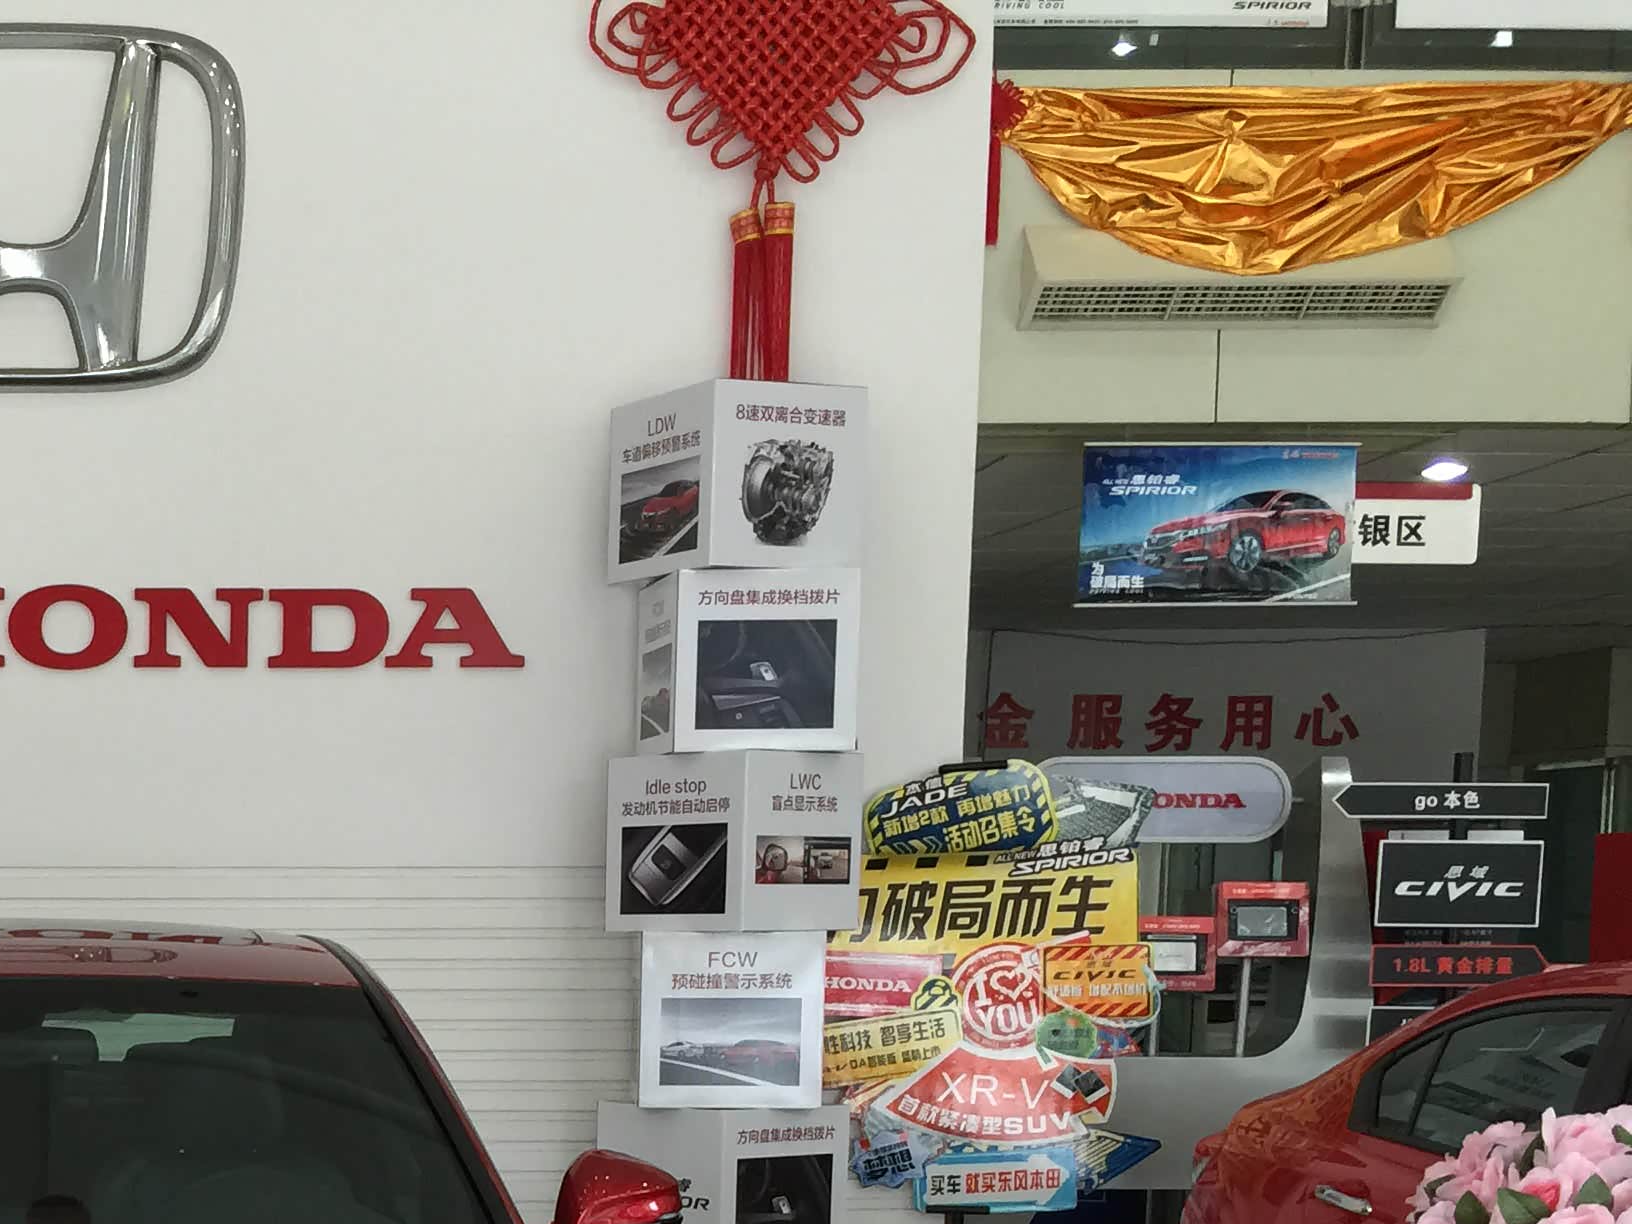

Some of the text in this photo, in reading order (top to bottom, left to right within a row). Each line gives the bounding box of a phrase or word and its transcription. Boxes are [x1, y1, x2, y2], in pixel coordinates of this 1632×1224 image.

[1232, 1, 1312, 10] SPIRIOR
[647, 412, 677, 437] LDW
[736, 404, 846, 427] 8速双离合变速器
[1109, 485, 1199, 496] SPIRIOR
[1358, 513, 1426, 547] 银区
[645, 778, 707, 796] Idle stop
[790, 773, 822, 791] LWC
[622, 797, 731, 817] 发动机节能自动启停
[772, 795, 838, 813] 盲点显示系统
[881, 783, 968, 818] JADE
[1152, 793, 1246, 808] ONDA
[1414, 792, 1480, 811] go 本色
[943, 806, 1036, 851] 活动召集令
[1011, 848, 1131, 875] SPIRIOR
[1444, 865, 1489, 879] 思域
[1395, 880, 1525, 903] CIVIC
[708, 951, 758, 968] FCW
[1393, 957, 1513, 975] 1.8L 黄金排量
[672, 973, 792, 990] 预碰撞警示系统
[826, 975, 913, 993] HONDA
[1053, 969, 1137, 982] CIVIC
[880, 1017, 946, 1047] 智享生活
[939, 1071, 1049, 1109] XR-V
[930, 1168, 1061, 1196] 买车 就买东风本田
